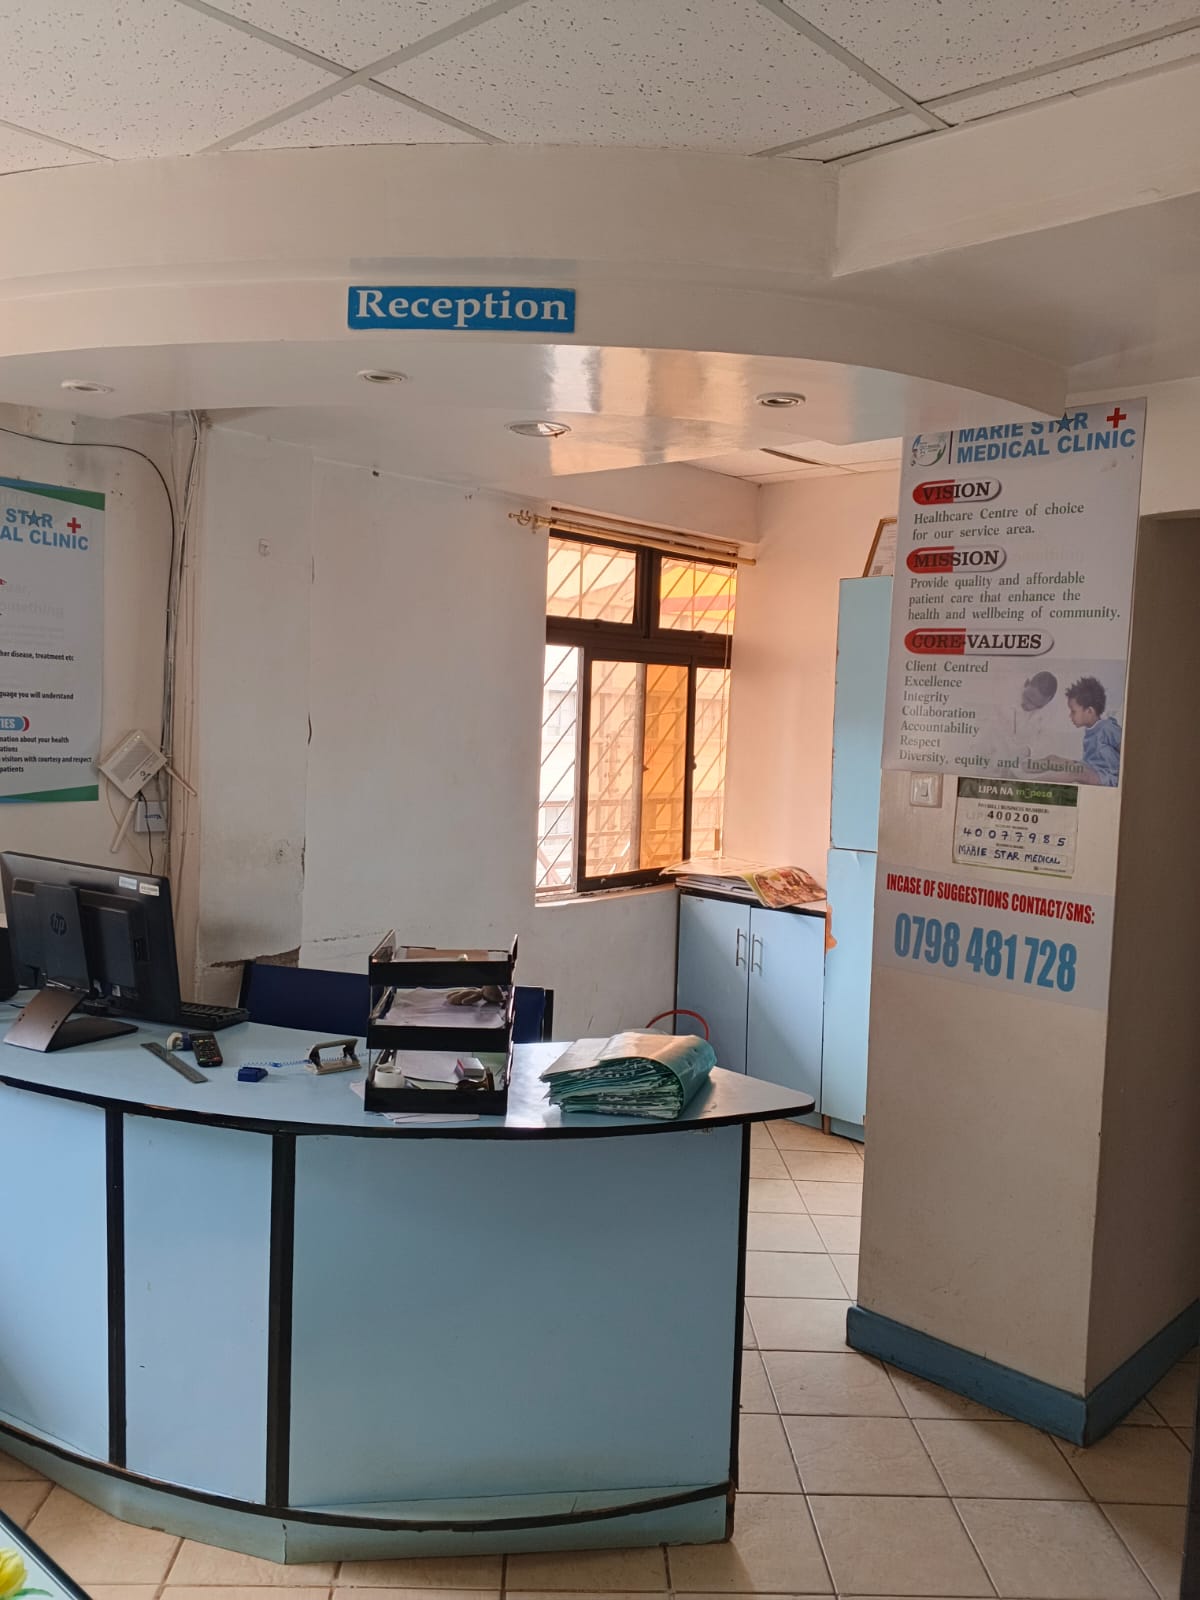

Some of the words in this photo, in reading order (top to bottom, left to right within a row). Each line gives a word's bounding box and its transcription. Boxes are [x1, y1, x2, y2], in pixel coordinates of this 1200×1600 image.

[355, 290, 568, 327] Reception
[959, 423, 1023, 443] MARIE
[956, 438, 1050, 464] MEDICAL
[1057, 428, 1136, 454] CLINIC
[922, 481, 991, 501] VISION
[6, 508, 53, 528] STAR
[914, 509, 973, 525] Healthcare
[980, 508, 1019, 520] Centre
[1025, 504, 1039, 517] of
[1044, 502, 1085, 515] choice
[29, 530, 88, 550] CLINIC
[912, 528, 928, 541] for
[934, 530, 953, 539] our
[959, 526, 1000, 538] service
[1006, 524, 1035, 534] area.
[913, 550, 999, 568] MISSION
[910, 576, 949, 589] Provide
[954, 576, 993, 590] quality
[999, 573, 1020, 586] and
[1026, 571, 1085, 585] affordable
[908, 594, 944, 607] patient
[950, 593, 974, 604] care
[980, 591, 1001, 603] that
[1008, 590, 1056, 602] enhance
[1062, 589, 1081, 601] the
[908, 608, 940, 620] health
[945, 607, 966, 620] and
[972, 606, 1025, 622] wellbeing
[1031, 605, 1043, 618] of
[1050, 605, 1120, 621] community.
[911, 634, 965, 649] CORE
[966, 634, 1042, 649] VALUES
[11, 651, 34, 659] disease,
[905, 660, 937, 672] Client
[943, 661, 989, 673] Centred
[904, 675, 963, 687] Excellence
[42, 692, 73, 700] understand
[903, 691, 949, 705] Integrity
[902, 705, 976, 719] Collaboration
[900, 720, 980, 737] Accountability
[900, 735, 940, 750] Respect
[954, 754, 990, 769] equity
[997, 756, 1020, 769] and
[1027, 758, 1084, 773] Inclusion
[978, 785, 998, 794] LIPA
[1000, 787, 1013, 796] NA
[987, 810, 1039, 823] 400200
[994, 850, 1019, 860] STAR
[886, 873, 921, 895] INCASE
[923, 879, 936, 897] OF
[937, 881, 1009, 910] SUGGESTIONS
[1011, 893, 1095, 925] CONTACT/SMS:
[50, 912, 67, 936] hp
[894, 912, 960, 968] 0798
[966, 926, 1018, 980] 481
[1023, 936, 1077, 992] 728
